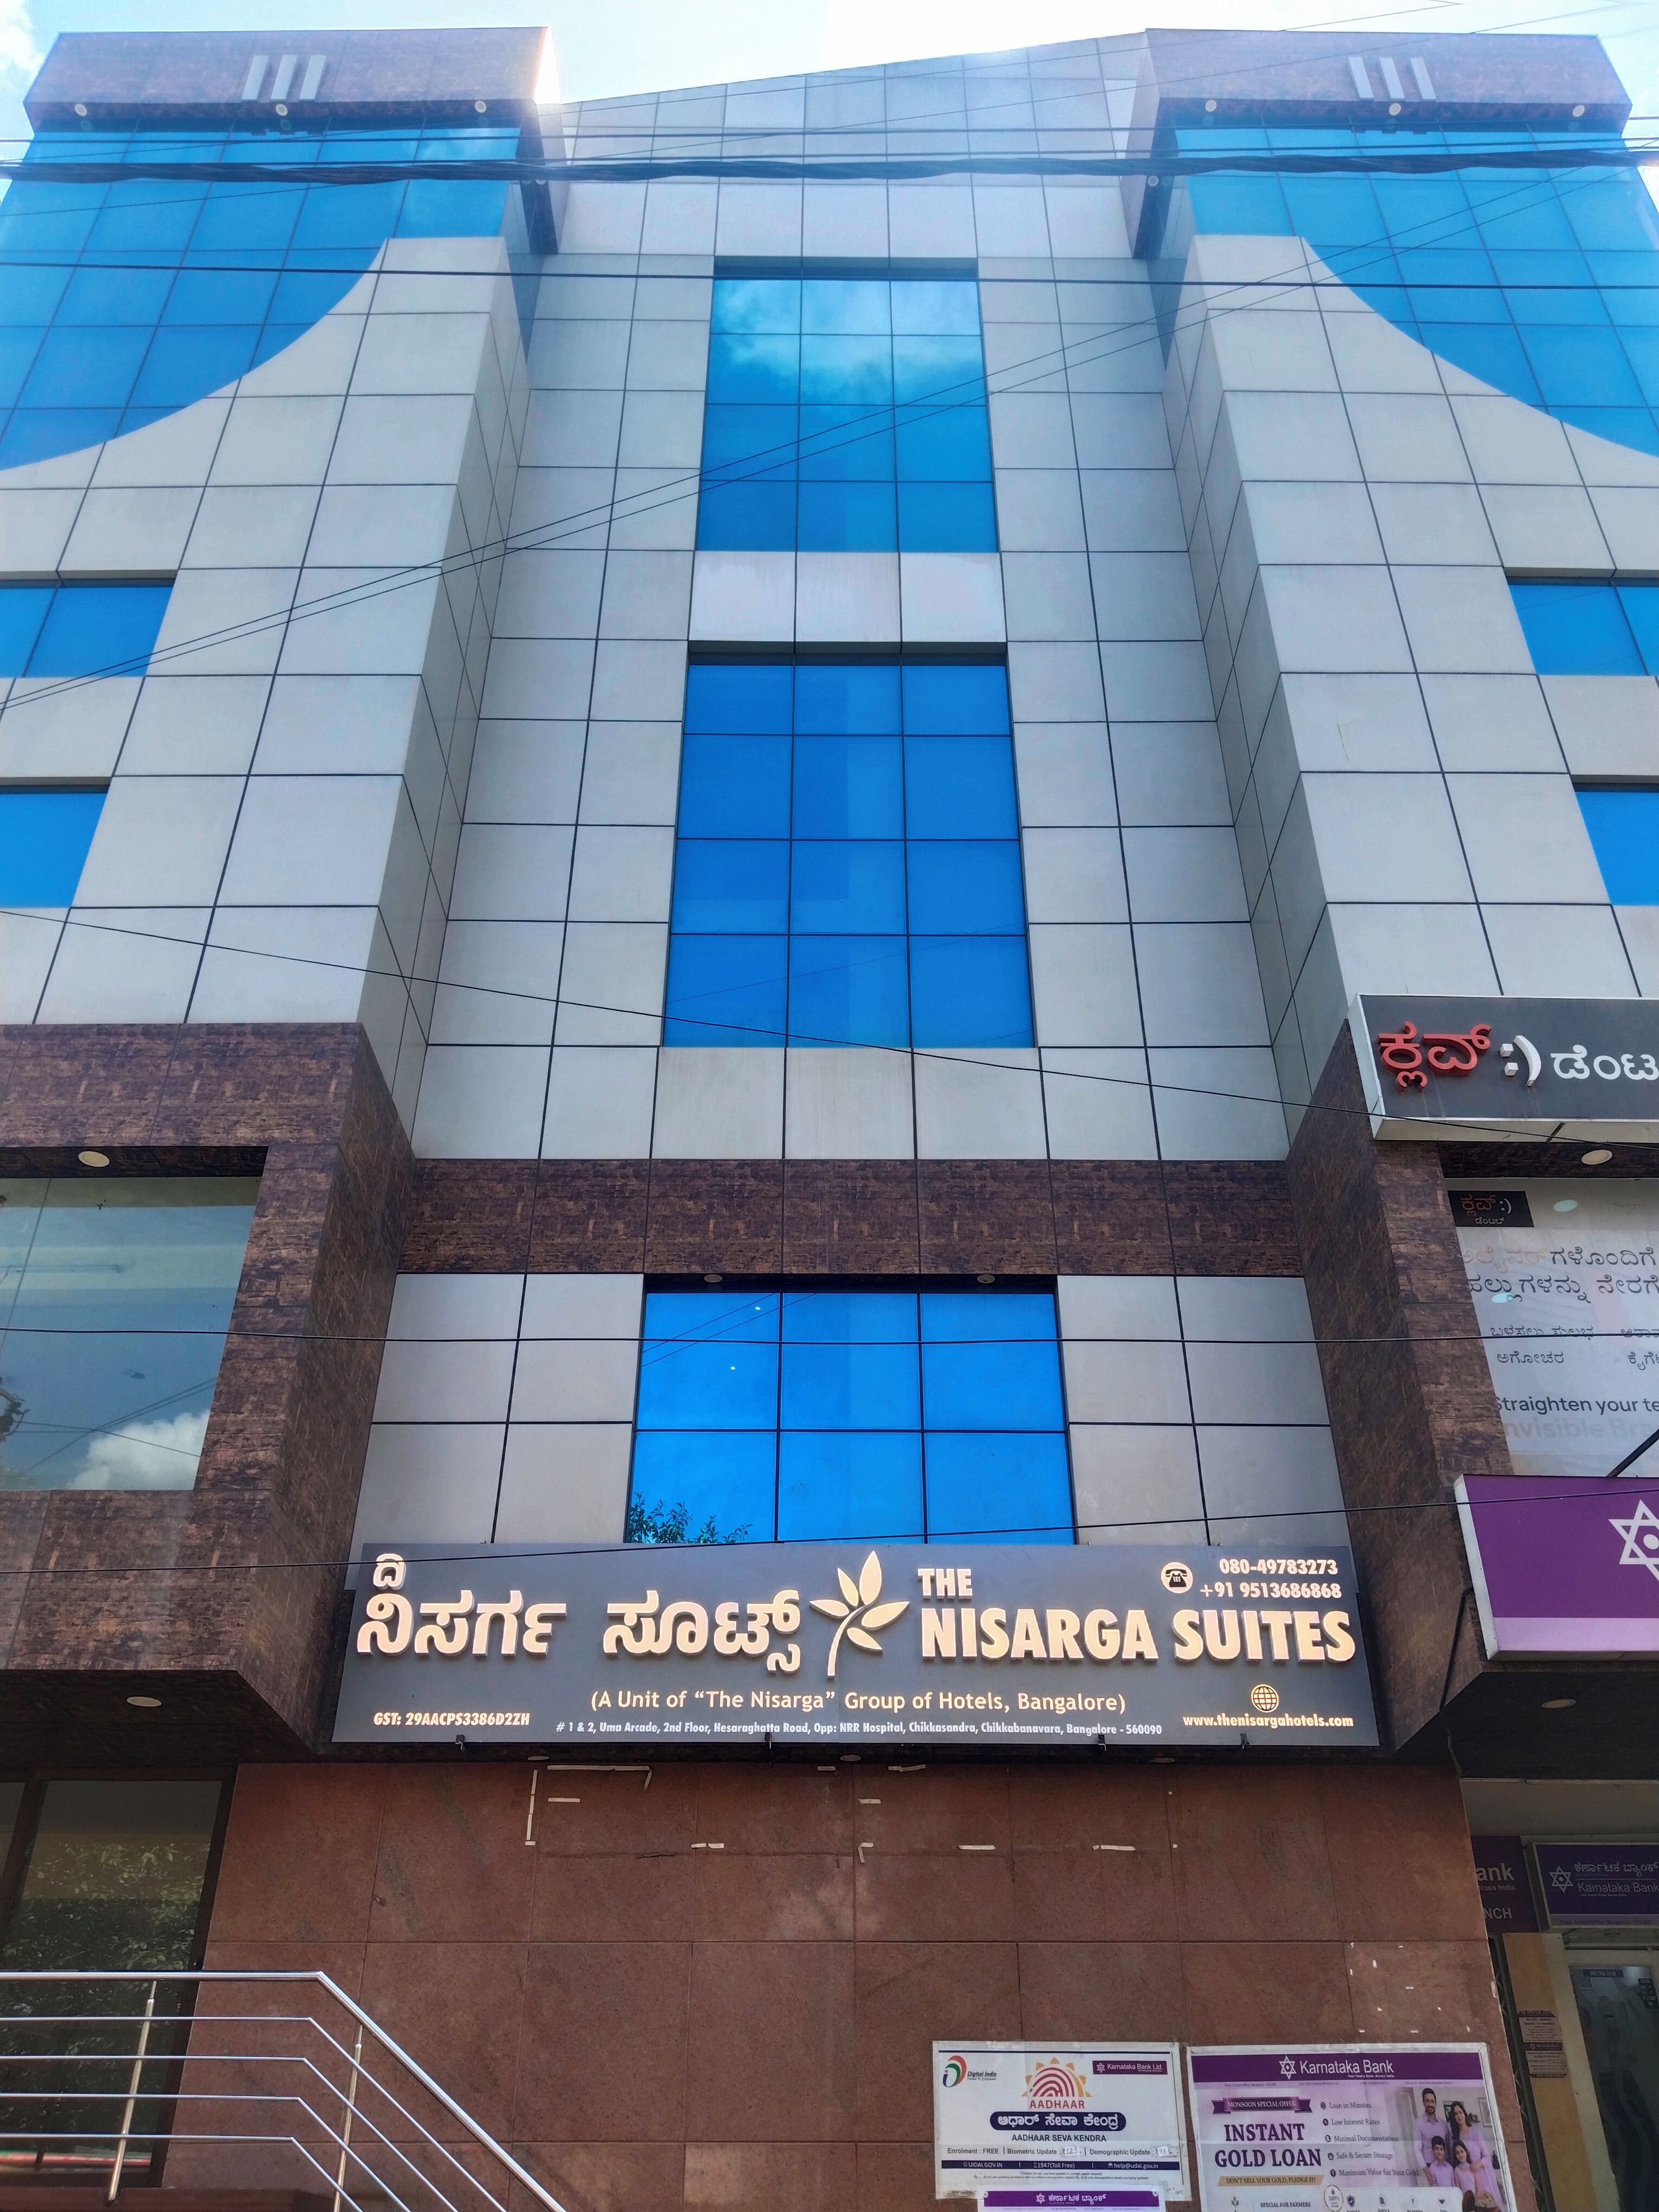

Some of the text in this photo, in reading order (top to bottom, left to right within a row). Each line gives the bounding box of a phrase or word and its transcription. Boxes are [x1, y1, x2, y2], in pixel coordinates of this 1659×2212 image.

[1497, 1350, 1565, 1364] ಅಗೋಚರ
[1595, 1400, 1638, 1415] your
[1503, 1417, 1604, 1438] nvisible
[373, 1553, 407, 1591] ದಿ
[1219, 1559, 1338, 1574] 080-49783273
[918, 1568, 973, 1599] THE
[1200, 1582, 1342, 1599] +91 9513686868
[357, 1590, 801, 1675] ನಿಸರ್ಗ ಸೂಟ್ಸ್
[921, 1608, 1356, 1662] NISARGA SUITES
[591, 1690, 612, 1710] (A
[618, 1691, 659, 1709] Unit
[666, 1691, 687, 1709] of
[844, 1692, 905, 1715] Group
[911, 1692, 933, 1710] of
[939, 1692, 1010, 1713] Hotels,
[1017, 1692, 1126, 1716] Bangalore)
[374, 1712, 531, 1726] GST: 29AACPS3386D2ZH
[1183, 1713, 1354, 1729] www.thenisargahotels.com
[556, 1722, 565, 1732] #
[577, 1722, 585, 1732] &
[588, 1722, 597, 1733] 2,
[600, 1722, 622, 1732] Uma
[624, 1722, 661, 1734] Arcade,
[663, 1722, 682, 1733] 2nd
[684, 1722, 711, 1734] Floor,
[714, 1722, 780, 1734] Hesaraghatta
[783, 1722, 811, 1734] Road,
[814, 1722, 837, 1735] Opp:
[840, 1722, 859, 1733] NRR
[863, 1722, 907, 1736] Hospital,
[909, 1722, 979, 1734] Chikkasandra,
[980, 1722, 1064, 1735] Chikkabanavara,
[1066, 1724, 1116, 1736] Bangalore
[1126, 1725, 1162, 1735] 560090
[1476, 1862, 1515, 1881] ank
[1577, 1881, 1659, 1893] Karnataka Bank
[1483, 1907, 1513, 1919] NCH
[1300, 2059, 1393, 2074] Karnataka Bank
[1029, 2100, 1085, 2109] AADHAAR
[1044, 2112, 1078, 2126] ಸೇವಾ
[1083, 2113, 1119, 2130] ಕೇಂದ್ರ
[1074, 2134, 1107, 2142] KENDRA
[1224, 2123, 1305, 2142] INSTANT
[1090, 2149, 1128, 2157] Demographic
[1215, 2148, 1322, 2168] GOLD LOAN
[1373, 2152, 1393, 2160] Storage
